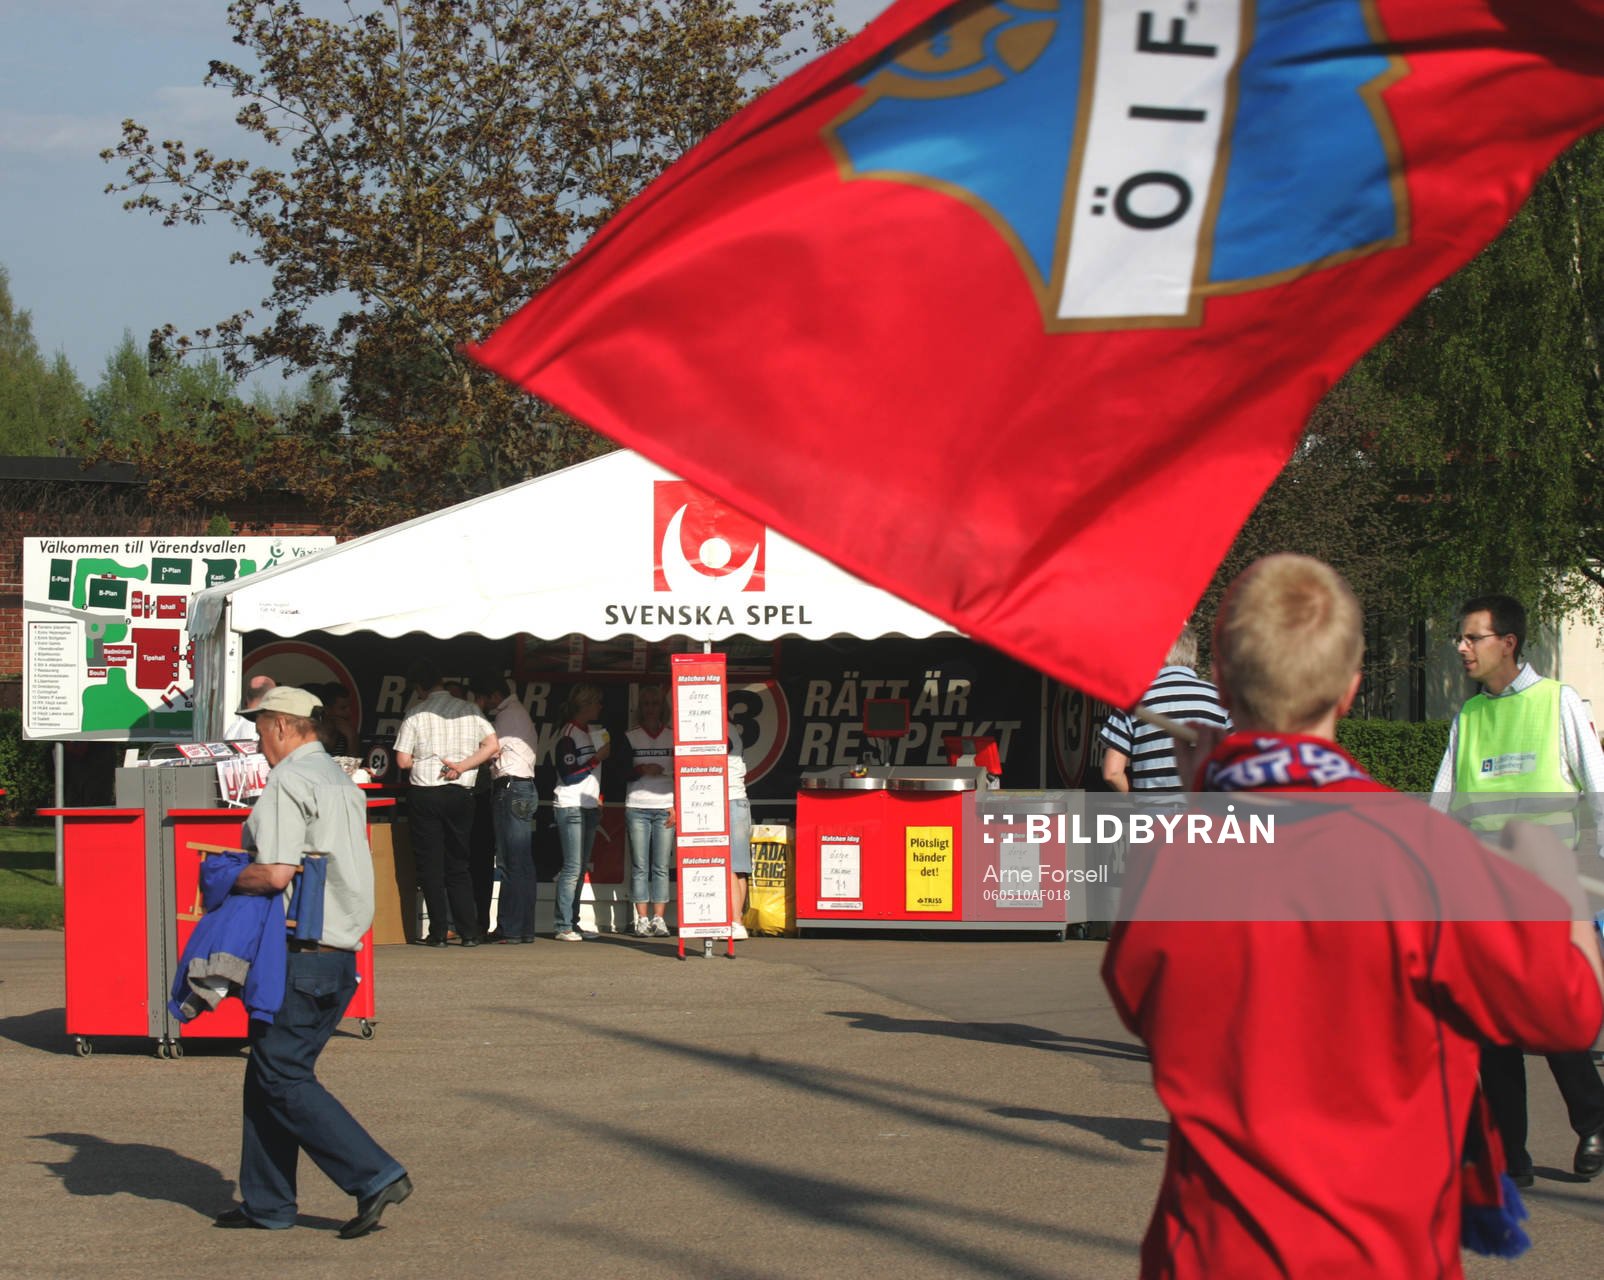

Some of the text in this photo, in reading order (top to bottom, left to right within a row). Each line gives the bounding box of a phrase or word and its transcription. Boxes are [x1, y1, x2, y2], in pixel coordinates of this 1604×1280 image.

[40, 540, 246, 554] Välkommen till Värendsvallen
[605, 604, 812, 626] SVENSKA SPEL
[912, 671, 972, 716] ÄR
[910, 838, 949, 850] Plötsligt
[912, 852, 946, 863] händer
[920, 867, 939, 877] det!
